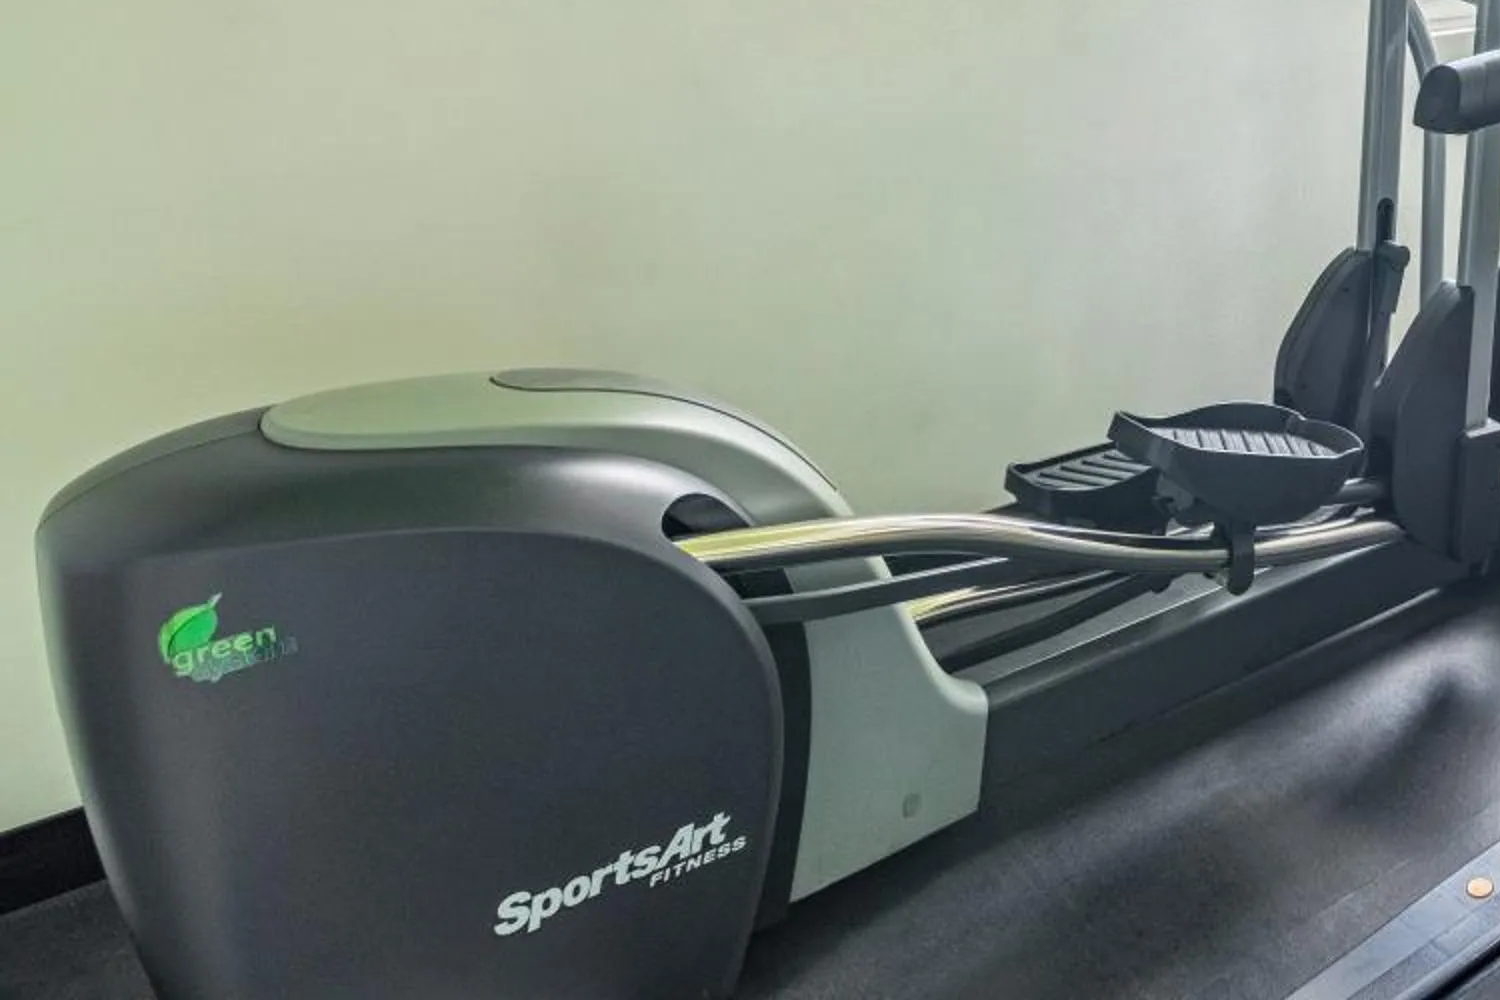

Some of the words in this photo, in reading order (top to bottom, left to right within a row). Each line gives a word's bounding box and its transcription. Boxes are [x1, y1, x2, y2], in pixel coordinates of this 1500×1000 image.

[172, 624, 277, 677] green
[494, 812, 730, 935] SportsArt
[650, 836, 747, 887] FITNESS
